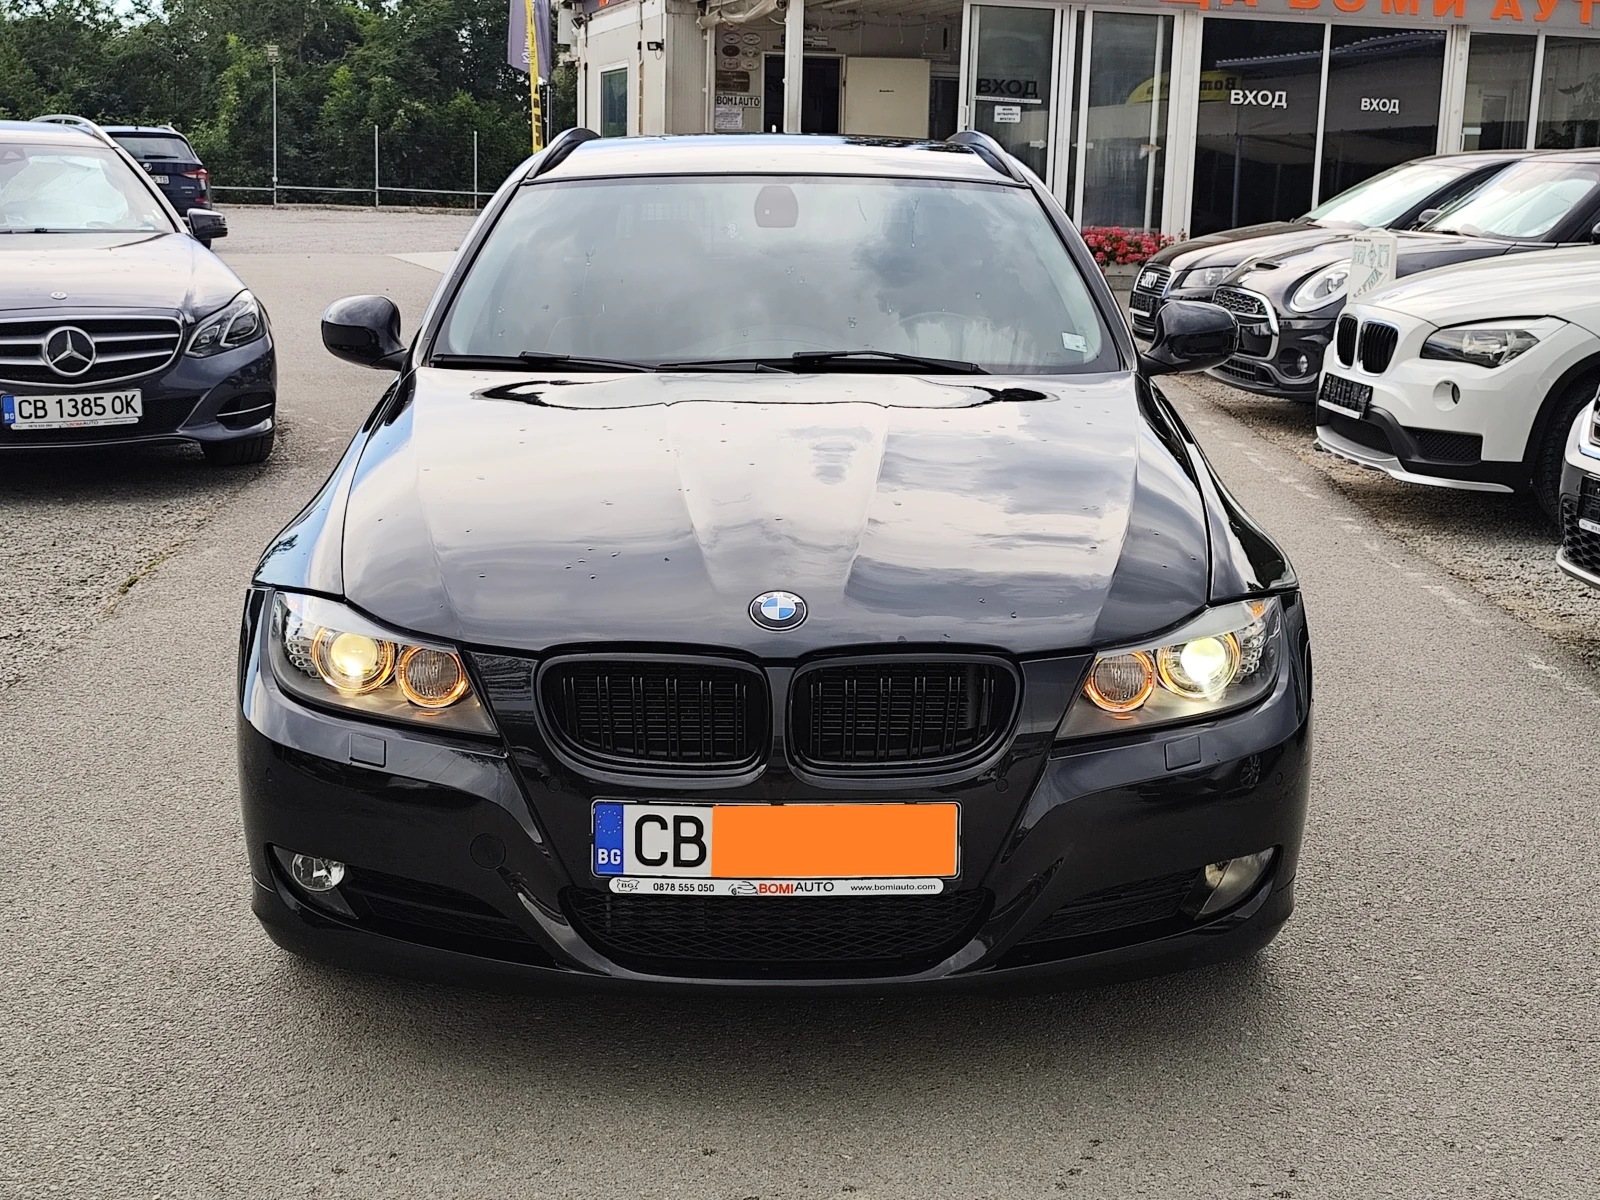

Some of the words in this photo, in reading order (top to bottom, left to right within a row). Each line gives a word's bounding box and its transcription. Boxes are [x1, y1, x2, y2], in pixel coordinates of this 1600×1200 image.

[976, 78, 1039, 98] ВХОД
[716, 96, 760, 107] BOMIAUTO
[1230, 89, 1288, 109] ВХОД
[1360, 98, 1400, 114] ВХОД
[18, 399, 48, 420] CB
[55, 396, 107, 418] 1385
[111, 394, 139, 415] OK
[634, 813, 708, 868] CB
[597, 848, 622, 865] BG
[653, 882, 676, 892] 0878
[678, 882, 696, 892] 555
[697, 883, 715, 893] 050
[850, 883, 936, 892] www.bomiauto.com
